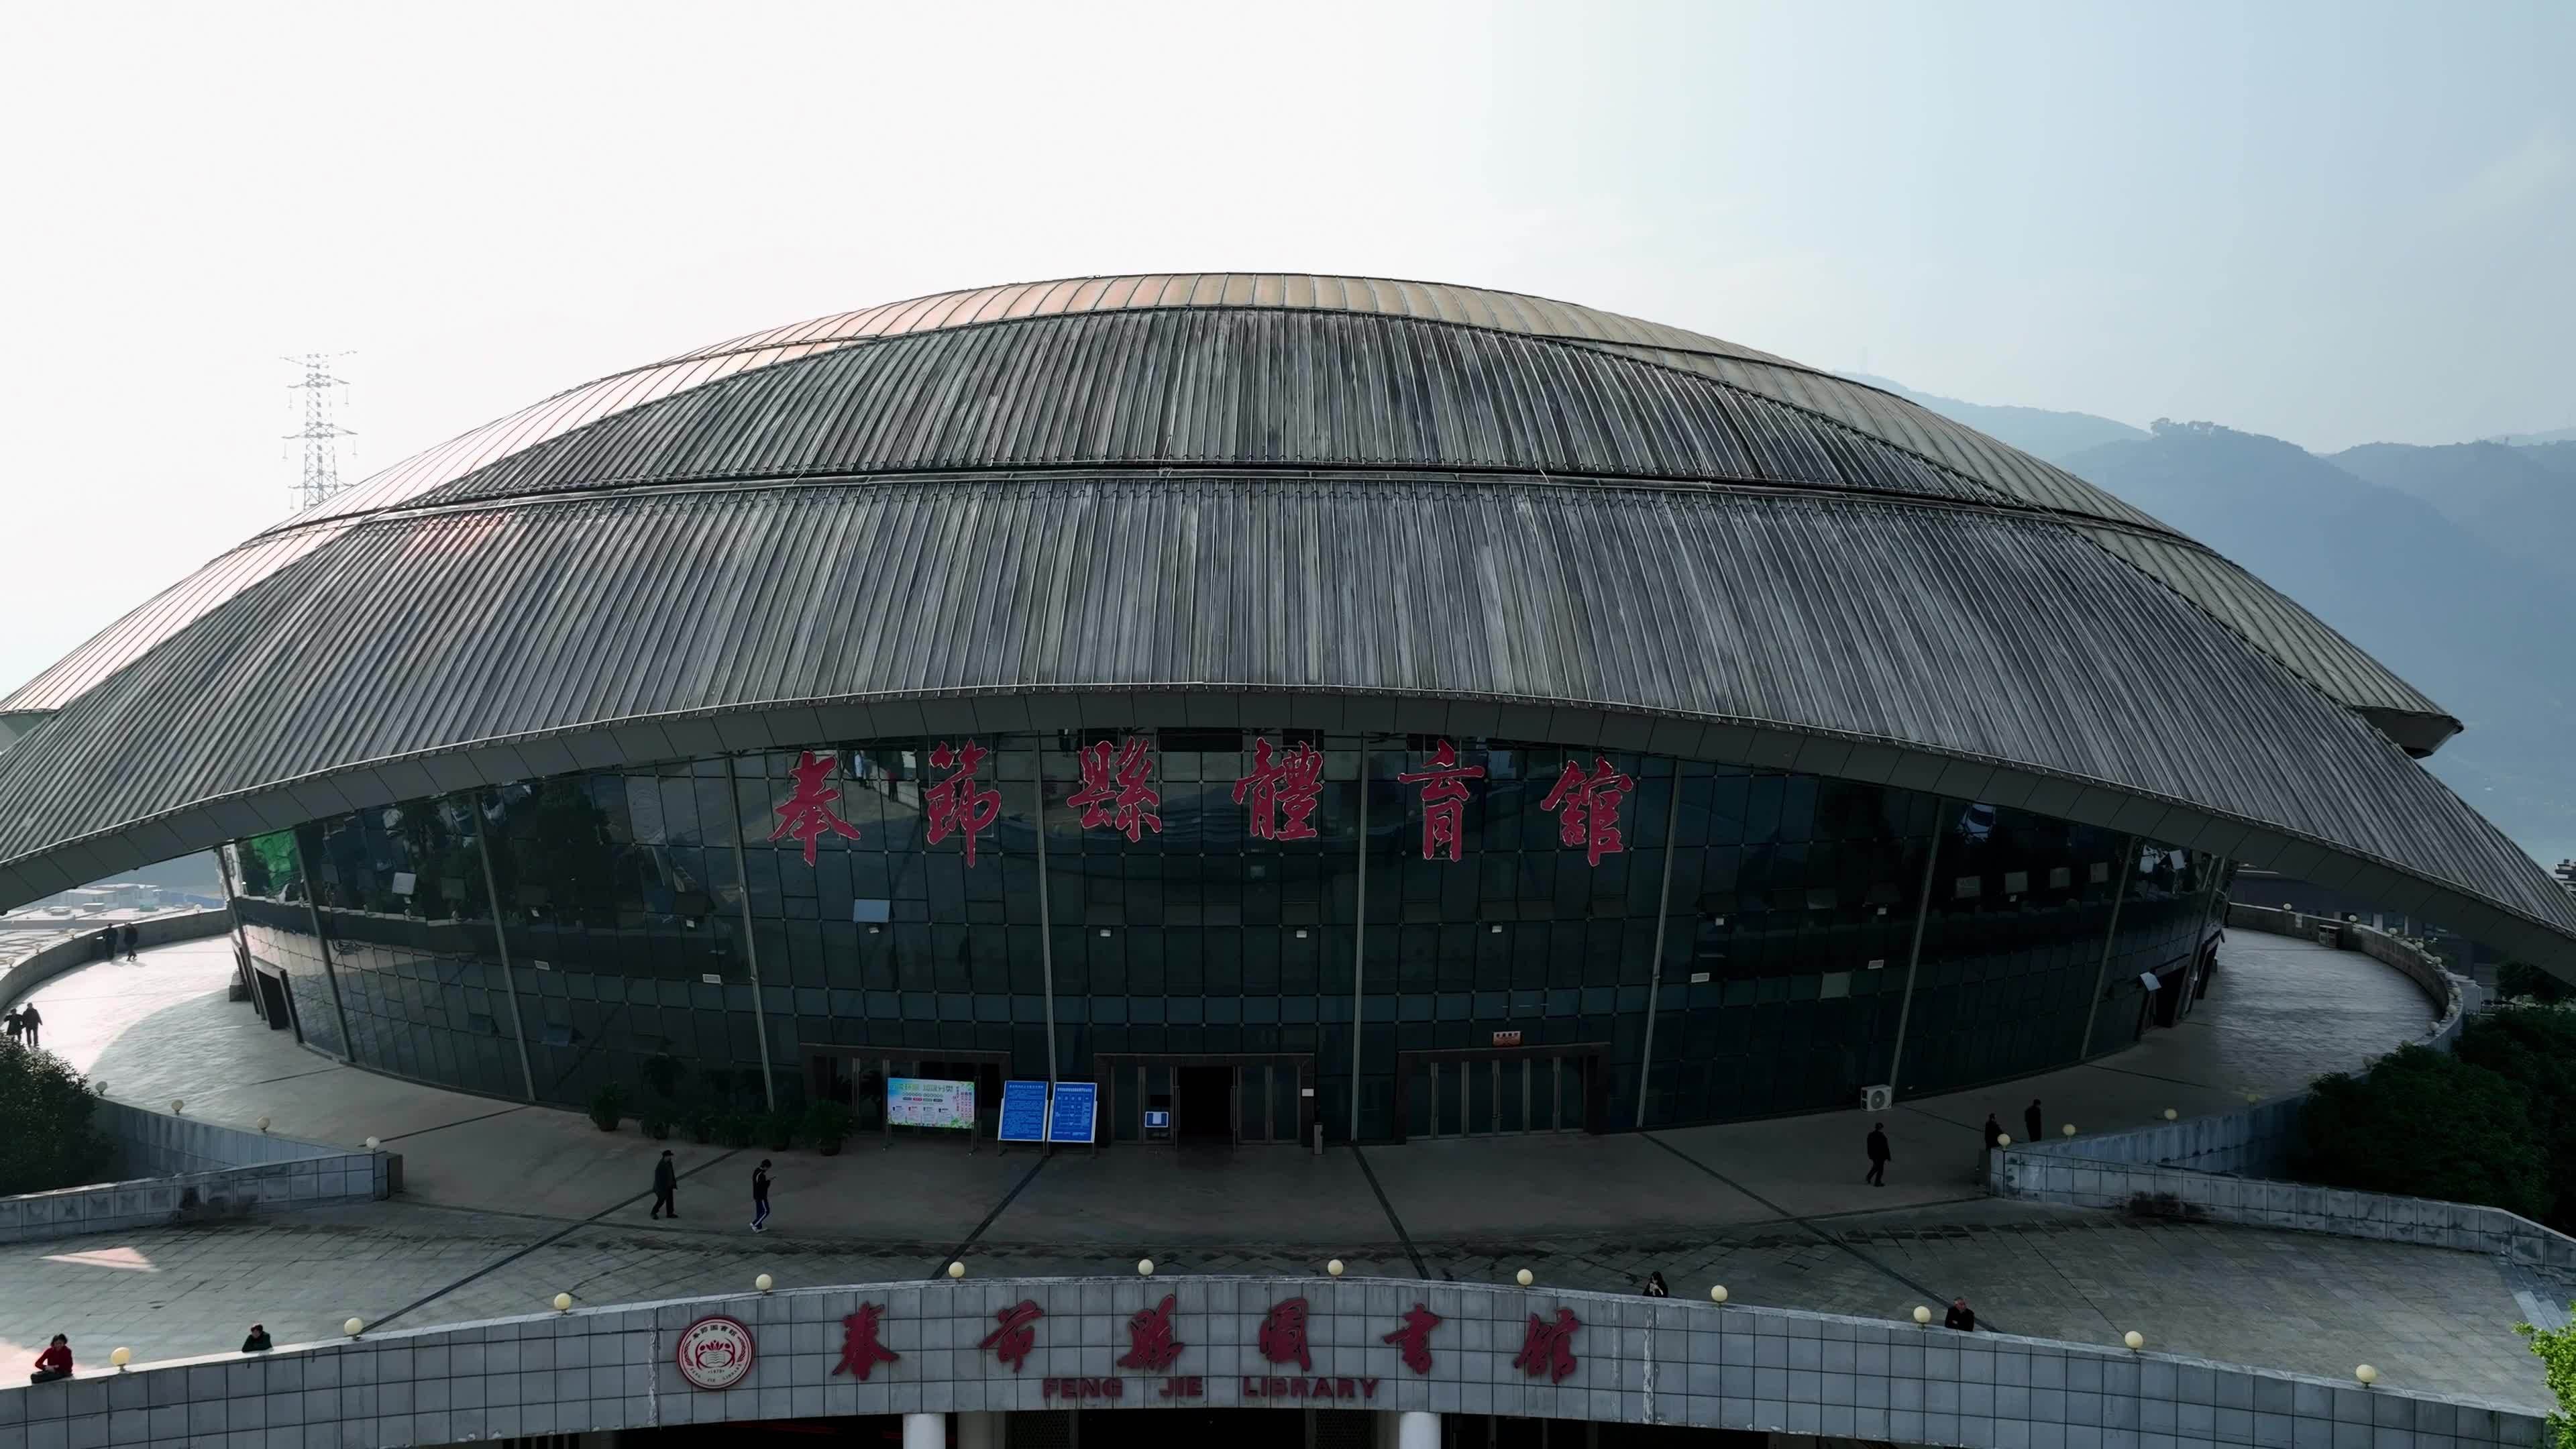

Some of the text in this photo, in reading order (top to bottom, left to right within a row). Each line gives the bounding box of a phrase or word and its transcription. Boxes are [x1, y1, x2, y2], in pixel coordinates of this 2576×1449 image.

[1042, 1376, 1379, 1399] FENG JIE LIBRARY
